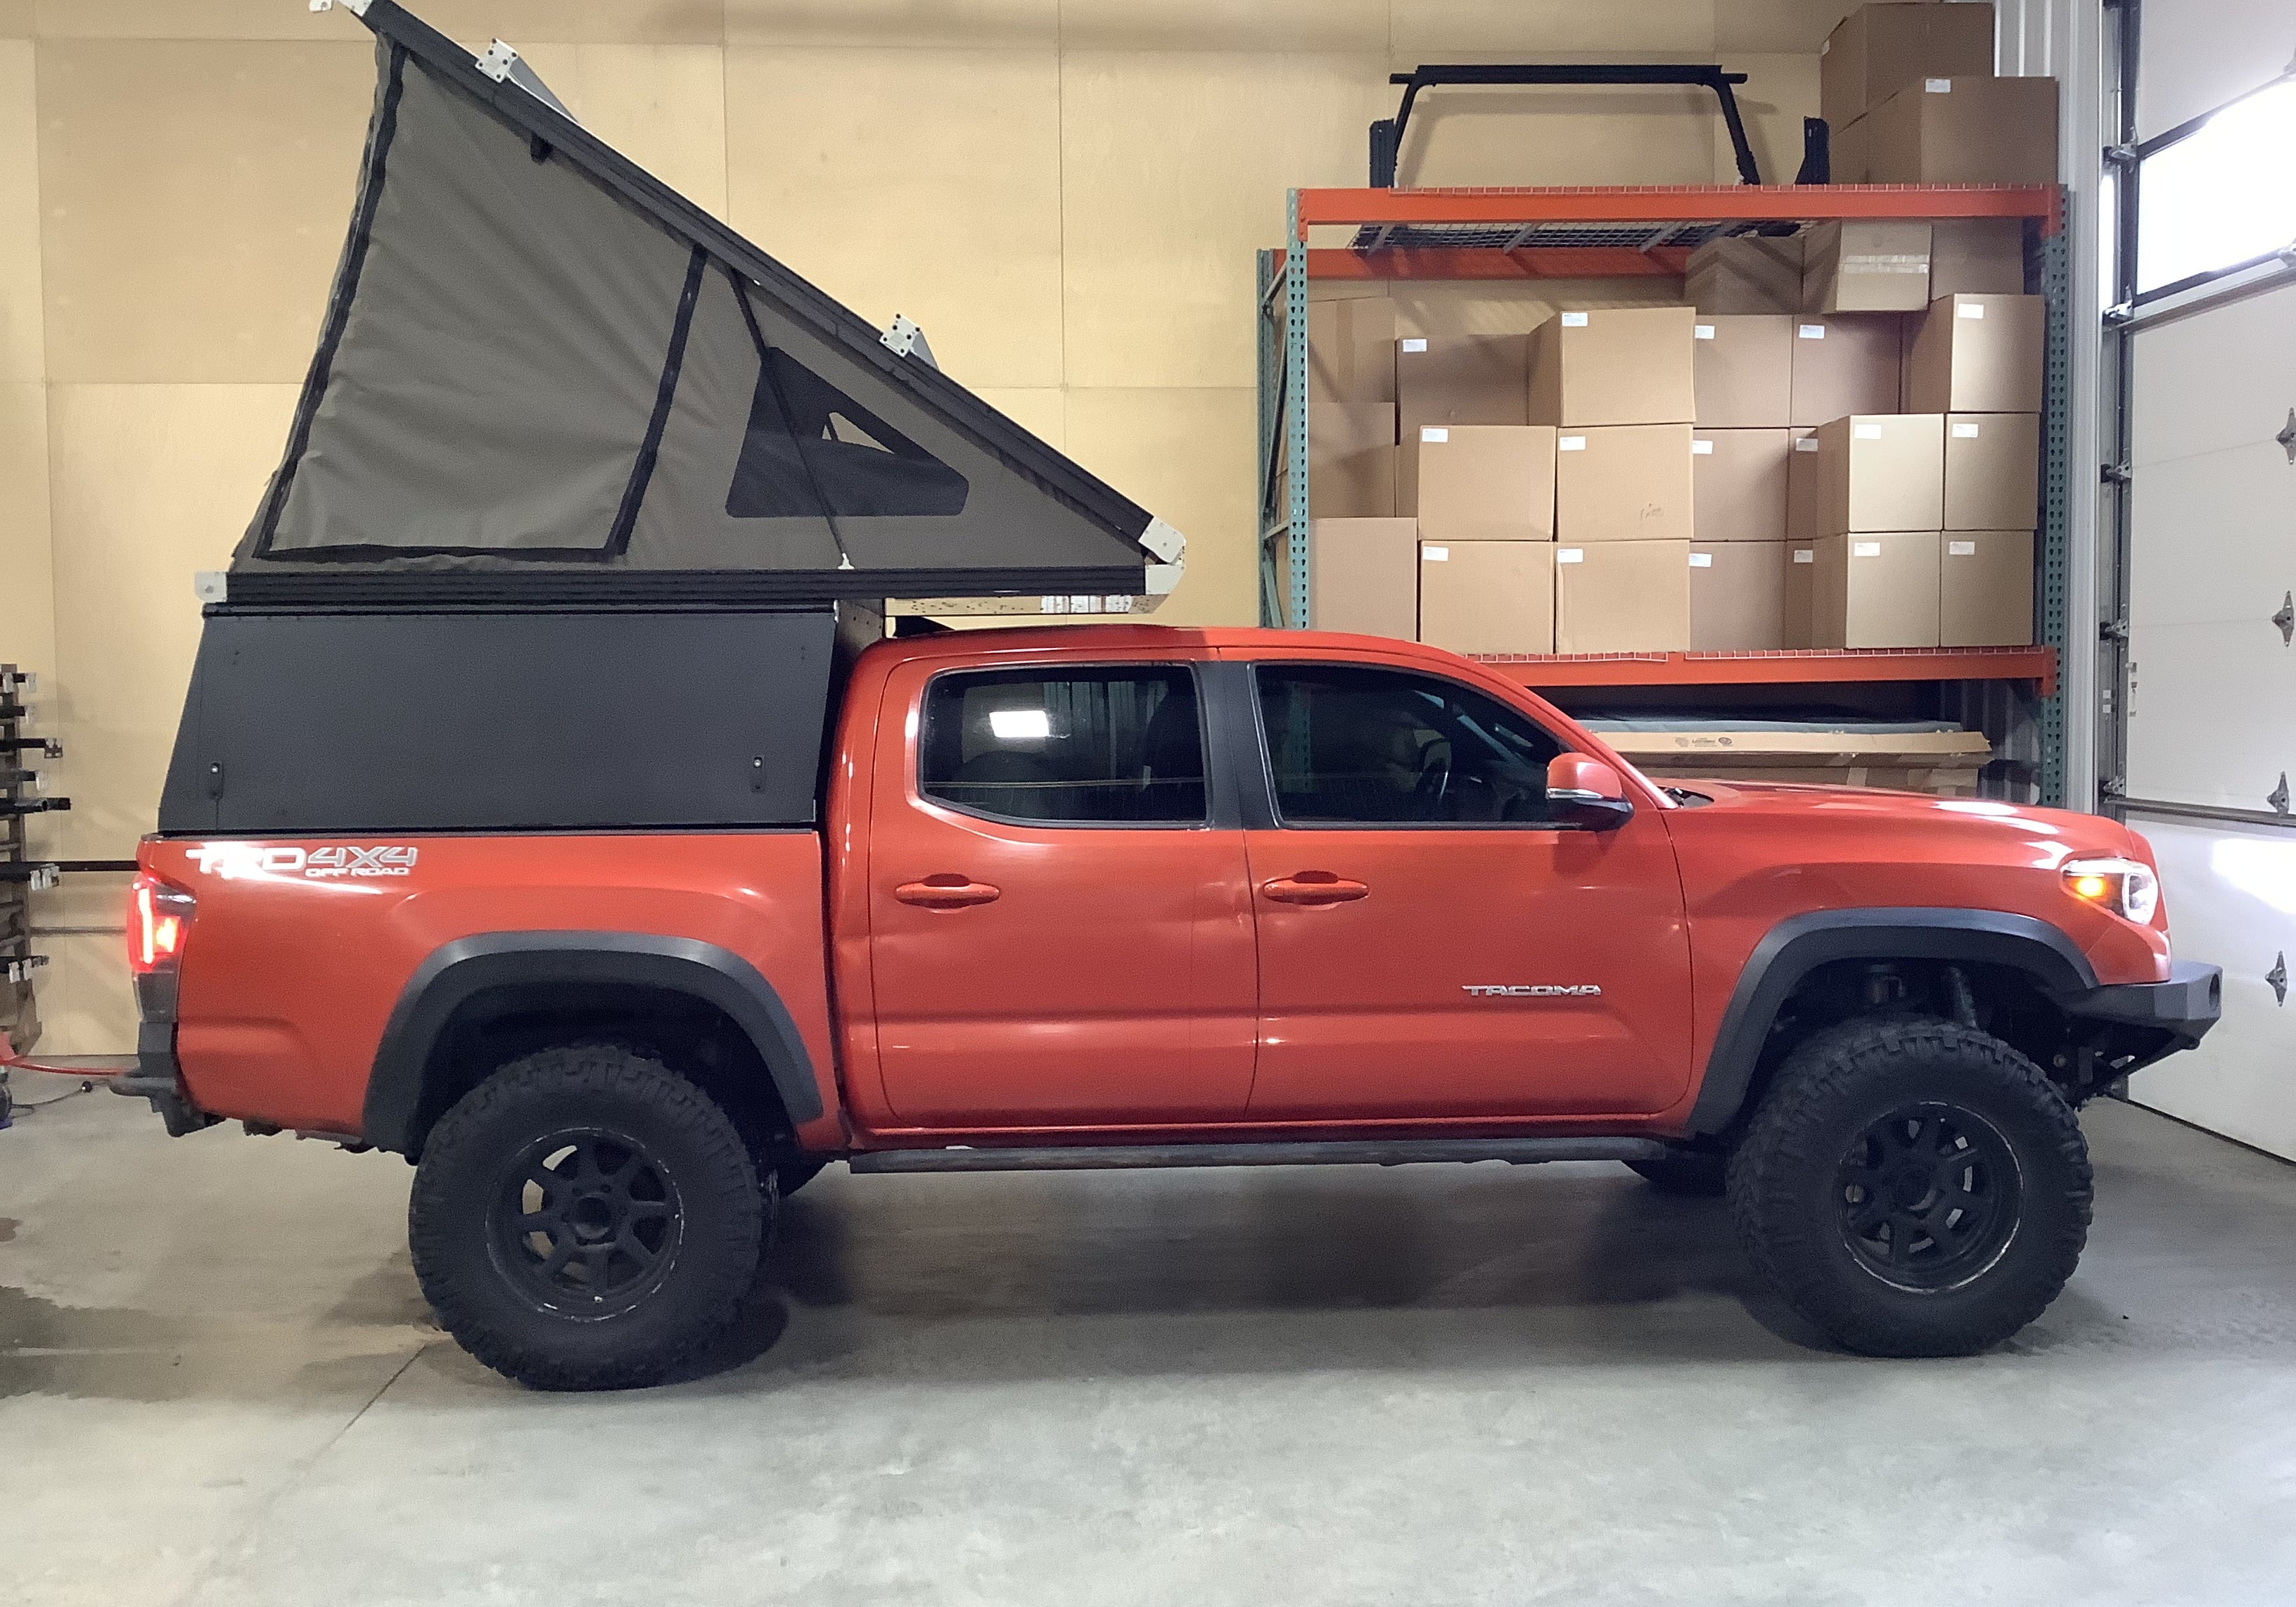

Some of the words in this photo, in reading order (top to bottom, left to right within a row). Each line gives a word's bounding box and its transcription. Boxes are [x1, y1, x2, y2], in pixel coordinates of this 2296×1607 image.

[305, 868, 348, 877] OFF
[351, 867, 410, 877] ROAD
[1462, 985, 1601, 996] TACOMA
